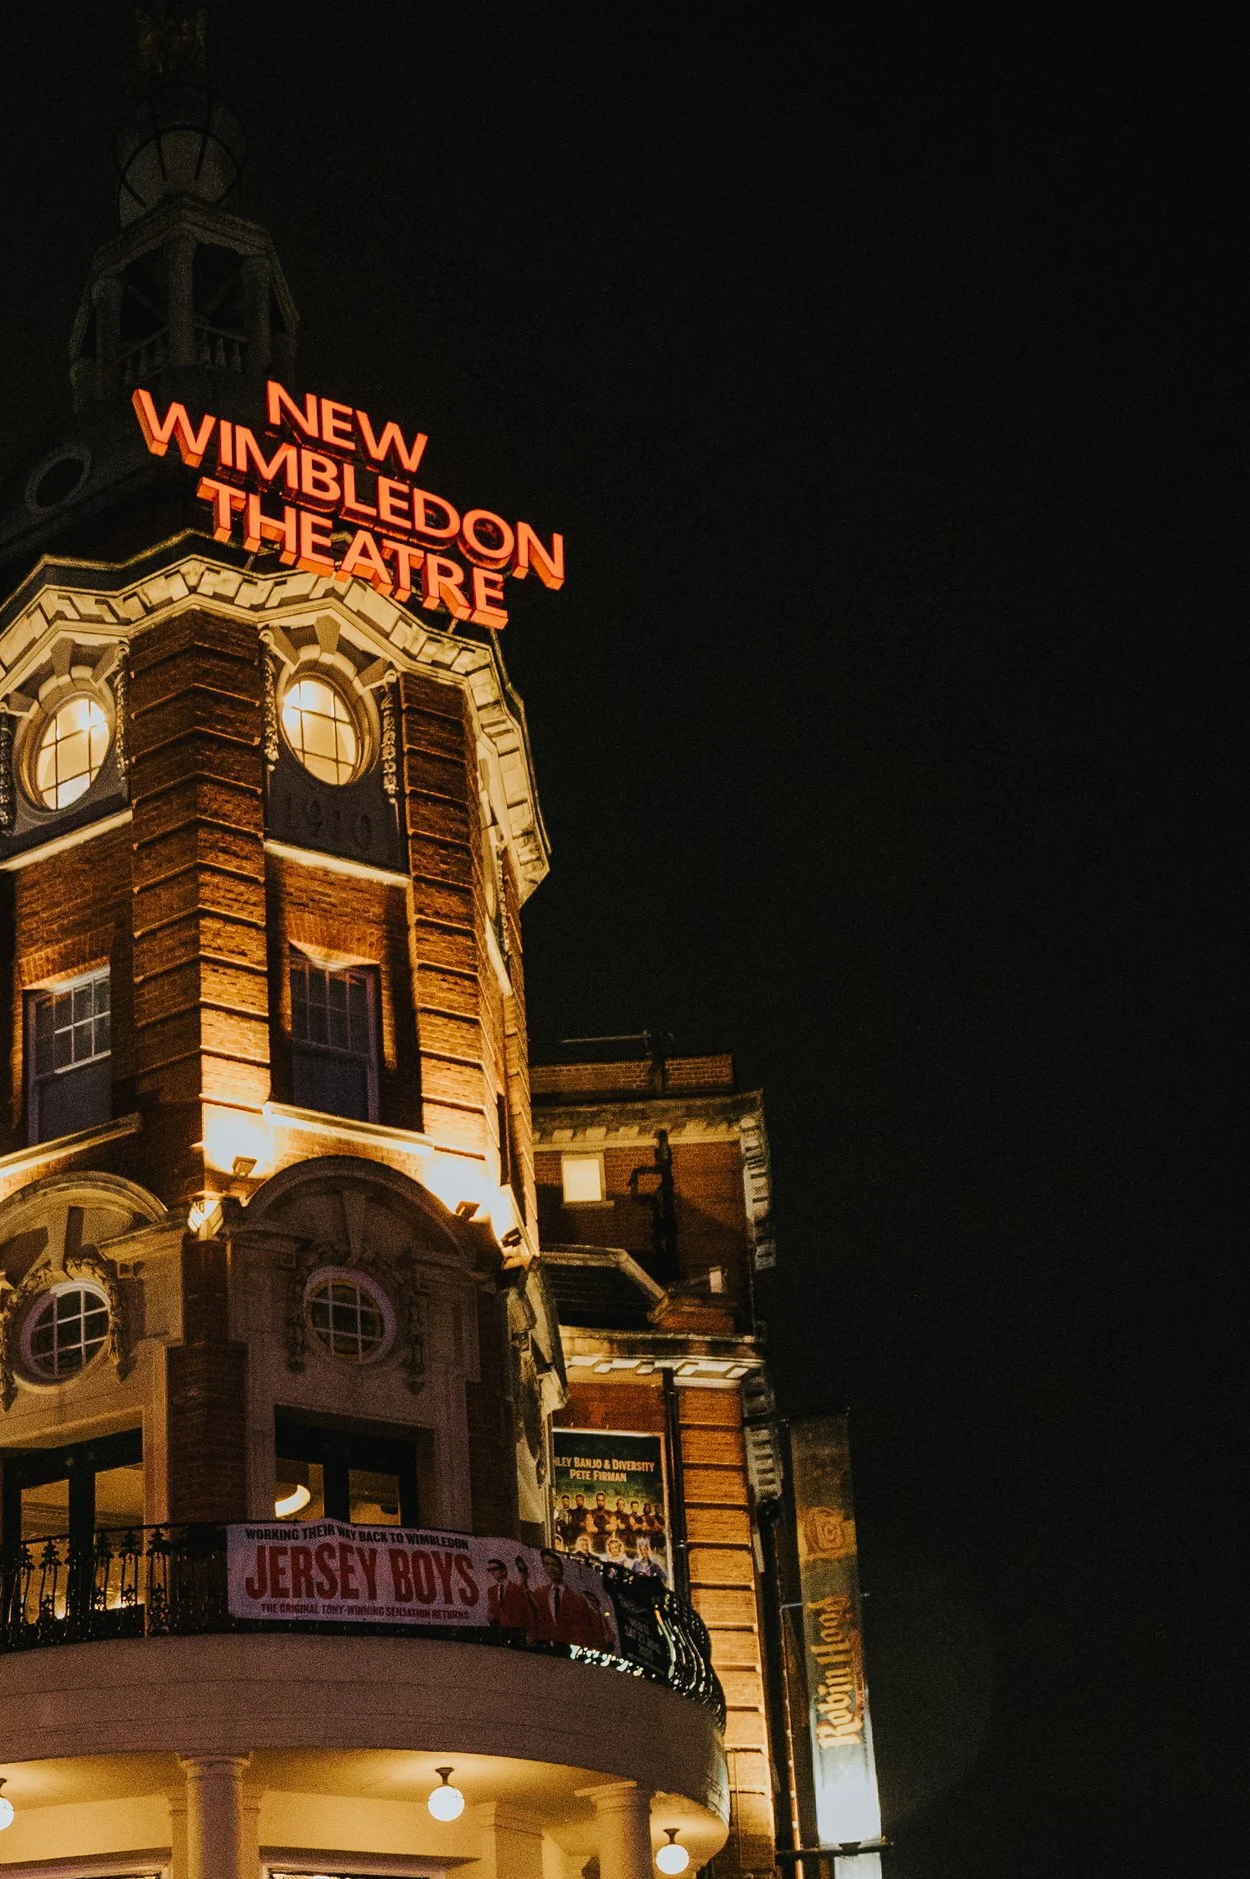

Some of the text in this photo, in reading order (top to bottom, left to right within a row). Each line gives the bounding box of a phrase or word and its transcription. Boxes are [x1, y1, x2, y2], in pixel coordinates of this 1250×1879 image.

[267, 380, 428, 473] NEW
[132, 388, 565, 590] WIMBLEDON
[196, 476, 509, 630] THEATRE
[284, 794, 373, 850] 1910
[554, 1456, 655, 1472] HLEY BANJO & DIVERSITY
[570, 1469, 627, 1482] PETE FIRMAN
[245, 1524, 469, 1550] WORKING THEIR WAY BACK TO WIMBLEDON
[245, 1541, 480, 1607] JERSEY BOYS
[261, 1603, 469, 1620] THE ORIGINAL TONY-WINNING SENSATION RETURNS
[816, 1668, 863, 1748] Robin
